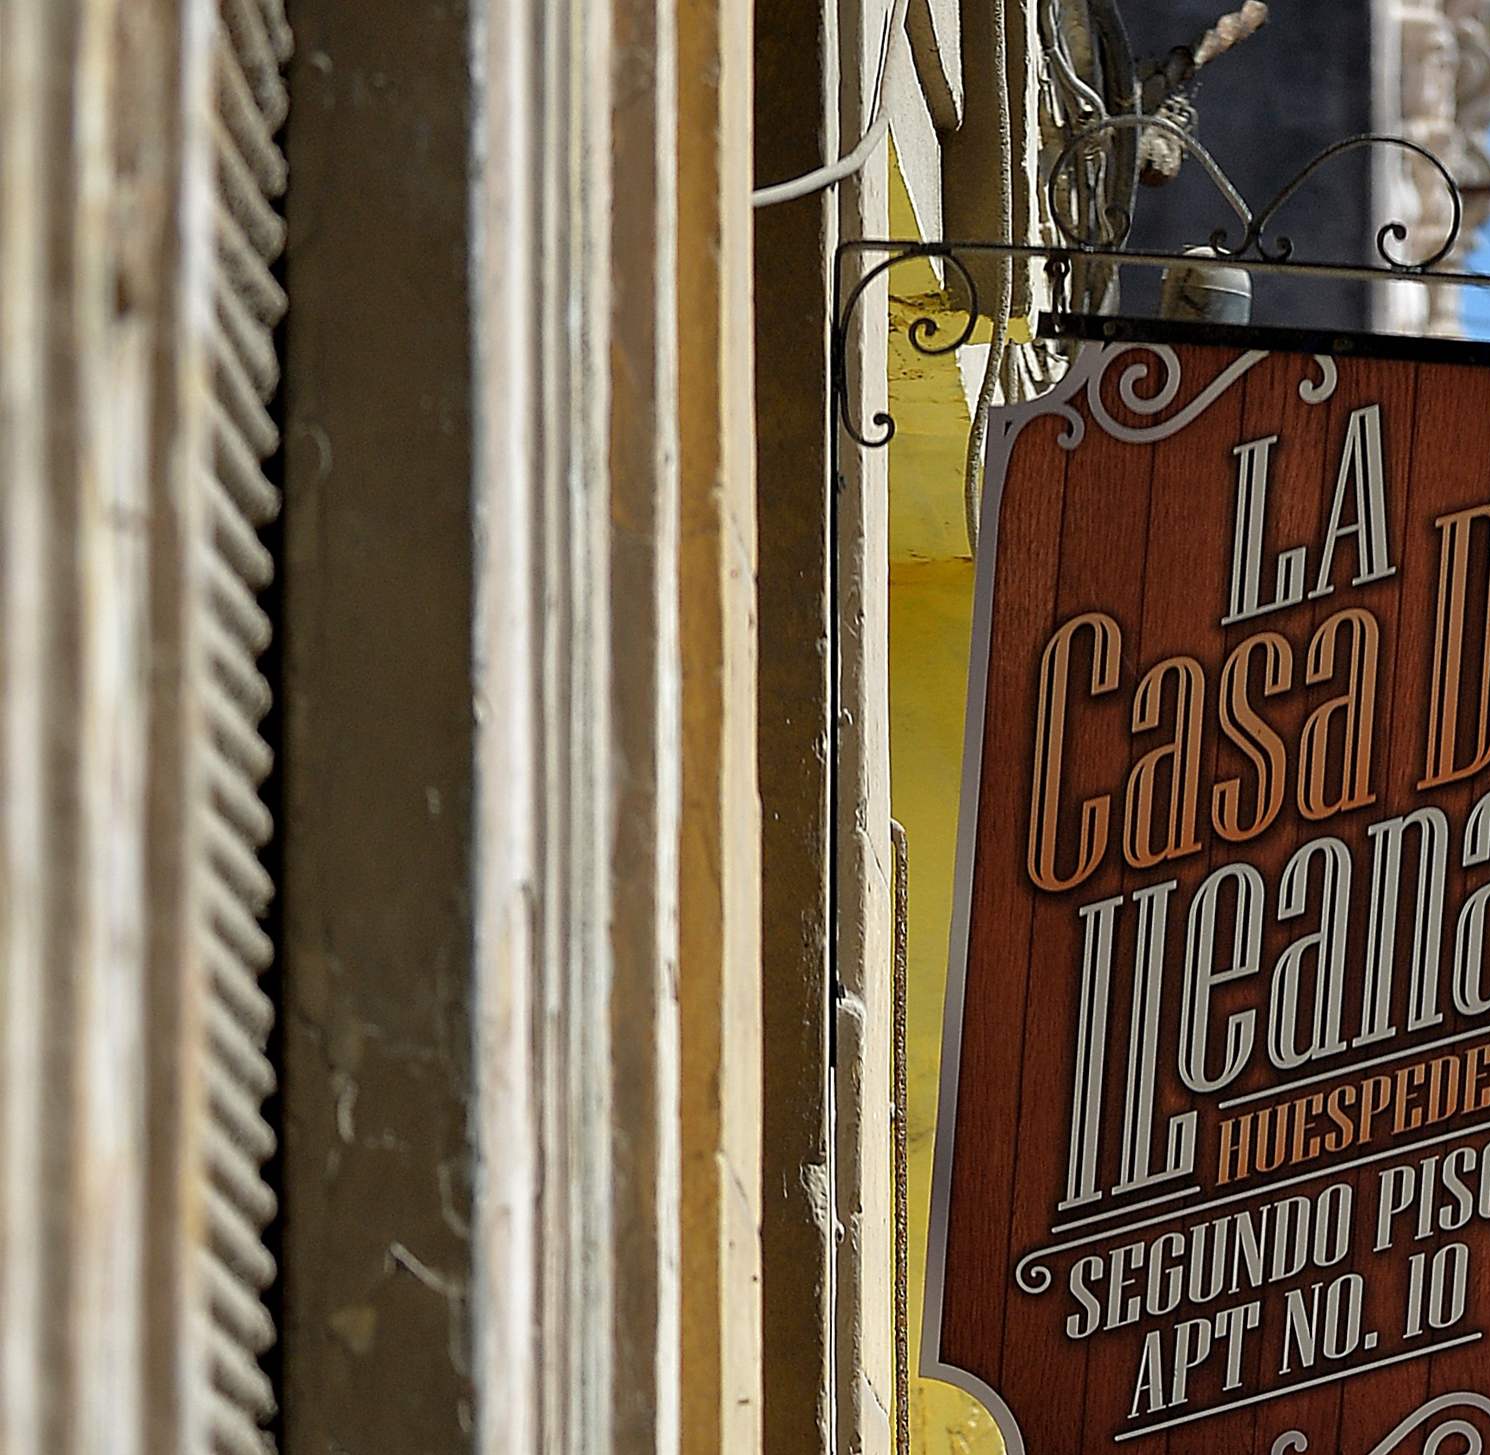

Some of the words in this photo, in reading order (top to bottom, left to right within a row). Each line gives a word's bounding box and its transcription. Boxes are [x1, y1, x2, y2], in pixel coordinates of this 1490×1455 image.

[1222, 406, 1397, 624] LA
[1027, 609, 1380, 892] Casa
[1065, 1182, 1353, 1339] SEGUNDO
[1127, 1300, 1260, 1420] APT
[1278, 1273, 1380, 1376] NO.
[1403, 1242, 1469, 1337] 10
